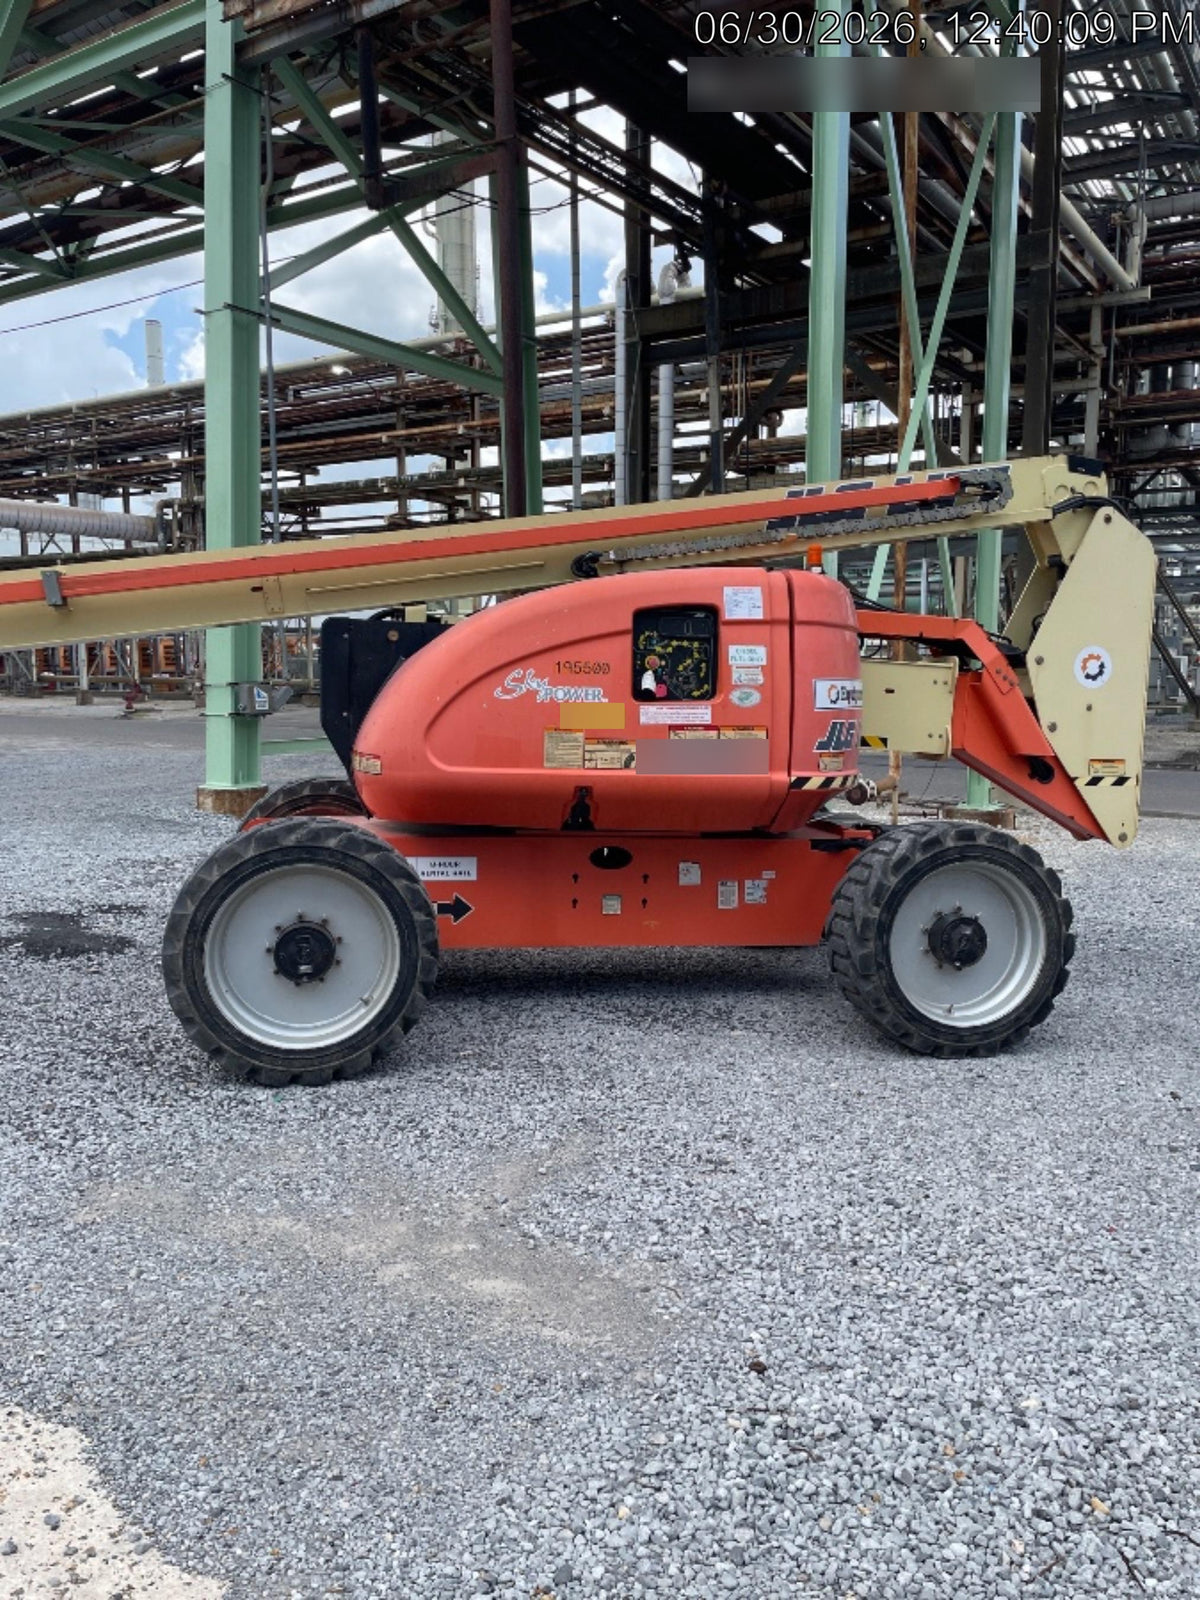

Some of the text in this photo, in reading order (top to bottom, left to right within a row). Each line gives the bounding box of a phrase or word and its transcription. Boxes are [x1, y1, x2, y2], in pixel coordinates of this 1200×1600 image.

[494, 668, 549, 702] Sky
[541, 686, 604, 702] POWER
[813, 720, 857, 752] JLG
